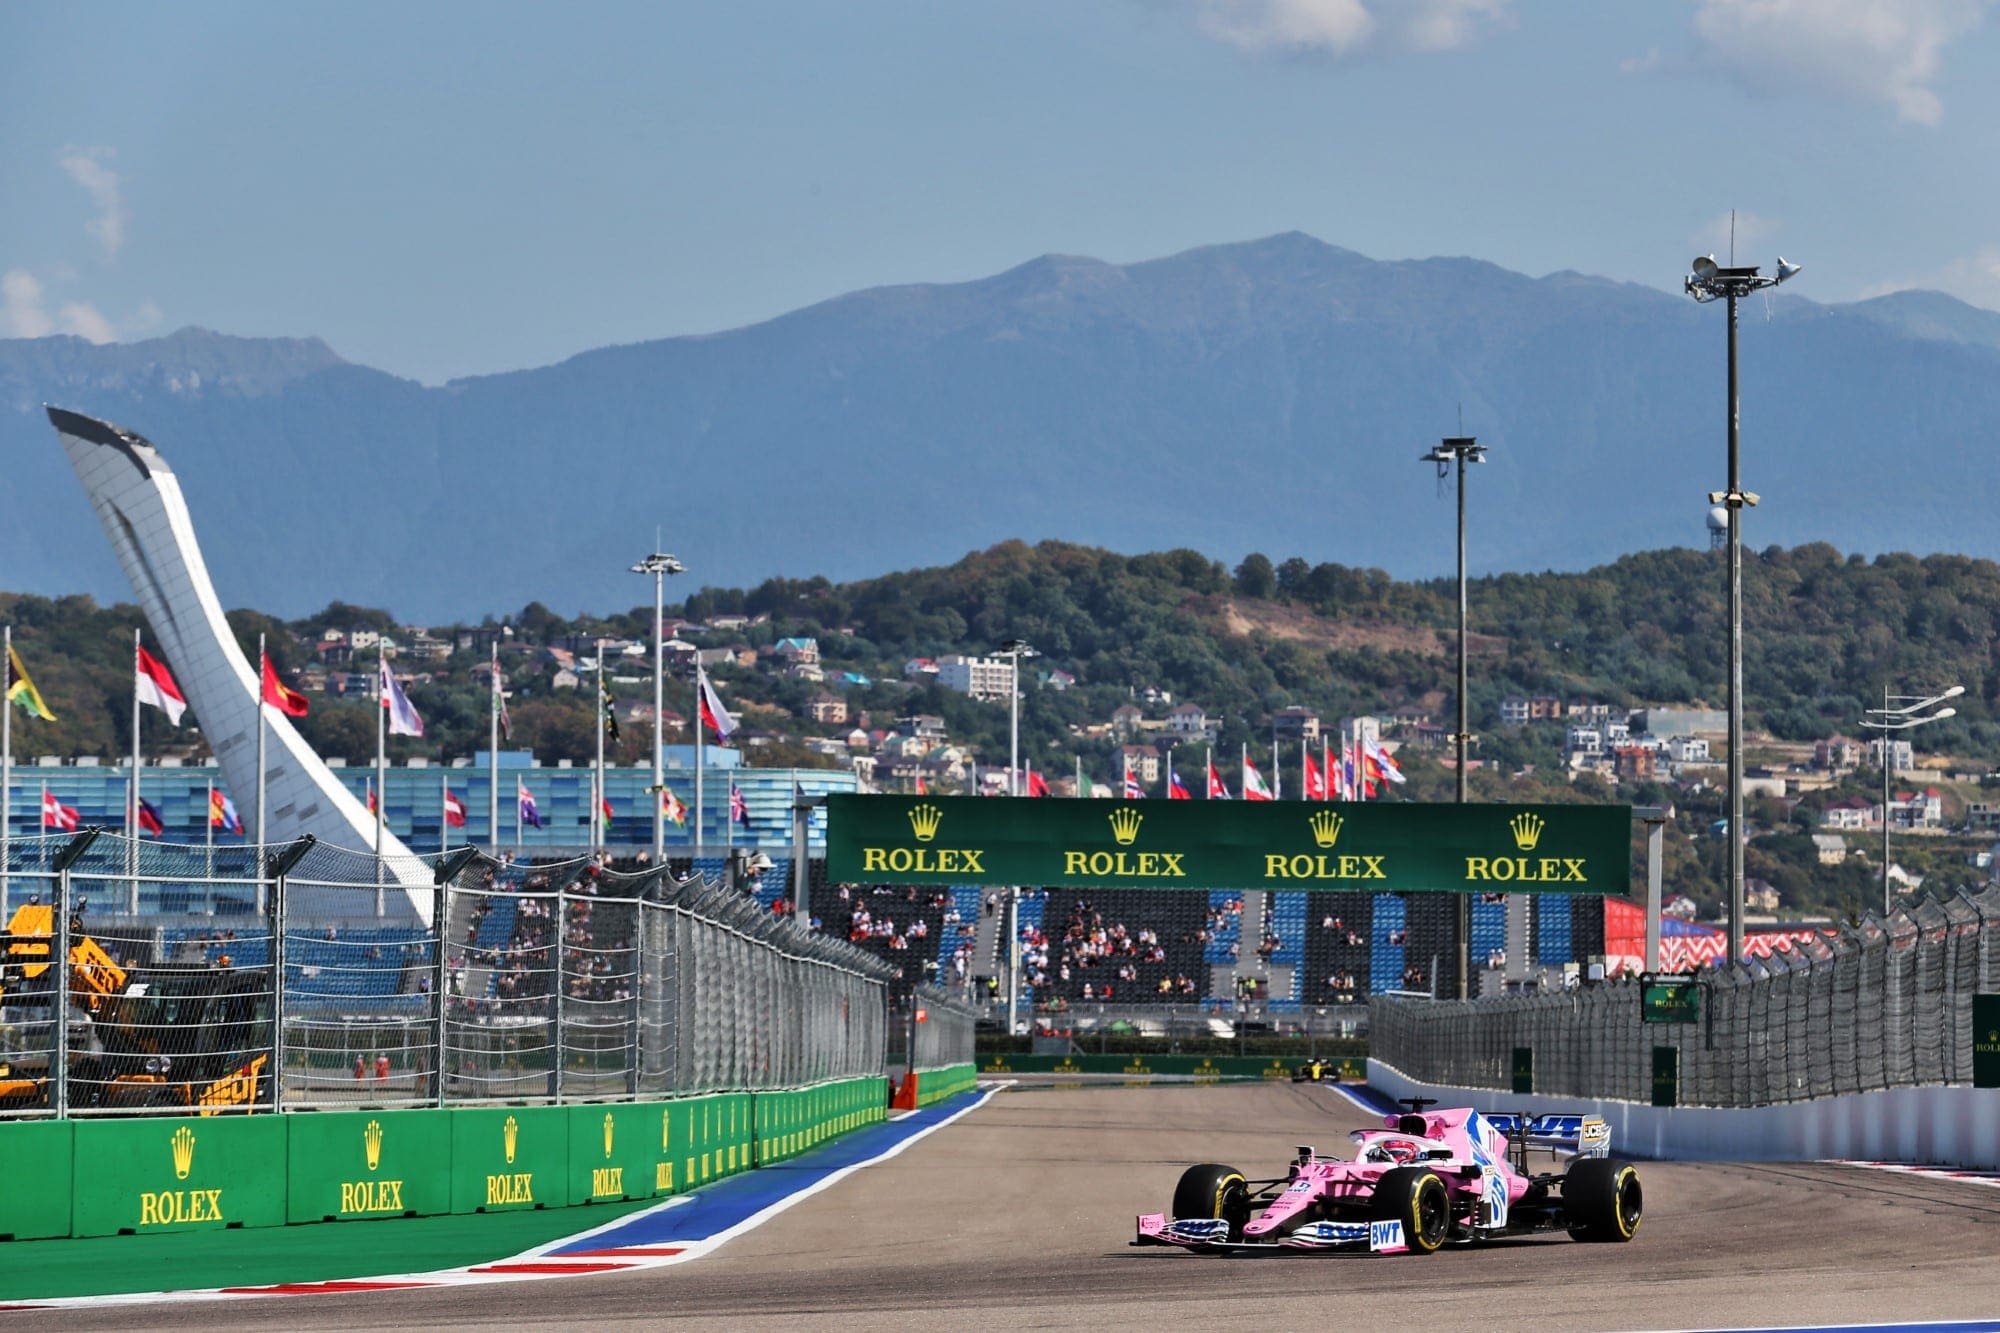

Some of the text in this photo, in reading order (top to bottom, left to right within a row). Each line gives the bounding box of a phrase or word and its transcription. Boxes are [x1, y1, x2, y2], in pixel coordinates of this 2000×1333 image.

[863, 848, 985, 873] ROLEX
[1064, 851, 1186, 877] ROLEX
[1265, 854, 1387, 880] ROLEX
[1465, 856, 1588, 883] ROLEX
[1655, 999, 1688, 1008] ROLEX
[1585, 1123, 1602, 1138] JCB
[486, 1173, 533, 1205] ROLEX
[592, 1167, 623, 1197] ROLEX
[140, 1189, 222, 1225] ROLEX
[341, 1180, 404, 1213] ROLEX
[1317, 1223, 1370, 1240] BW
[1372, 1222, 1401, 1246] BWT
